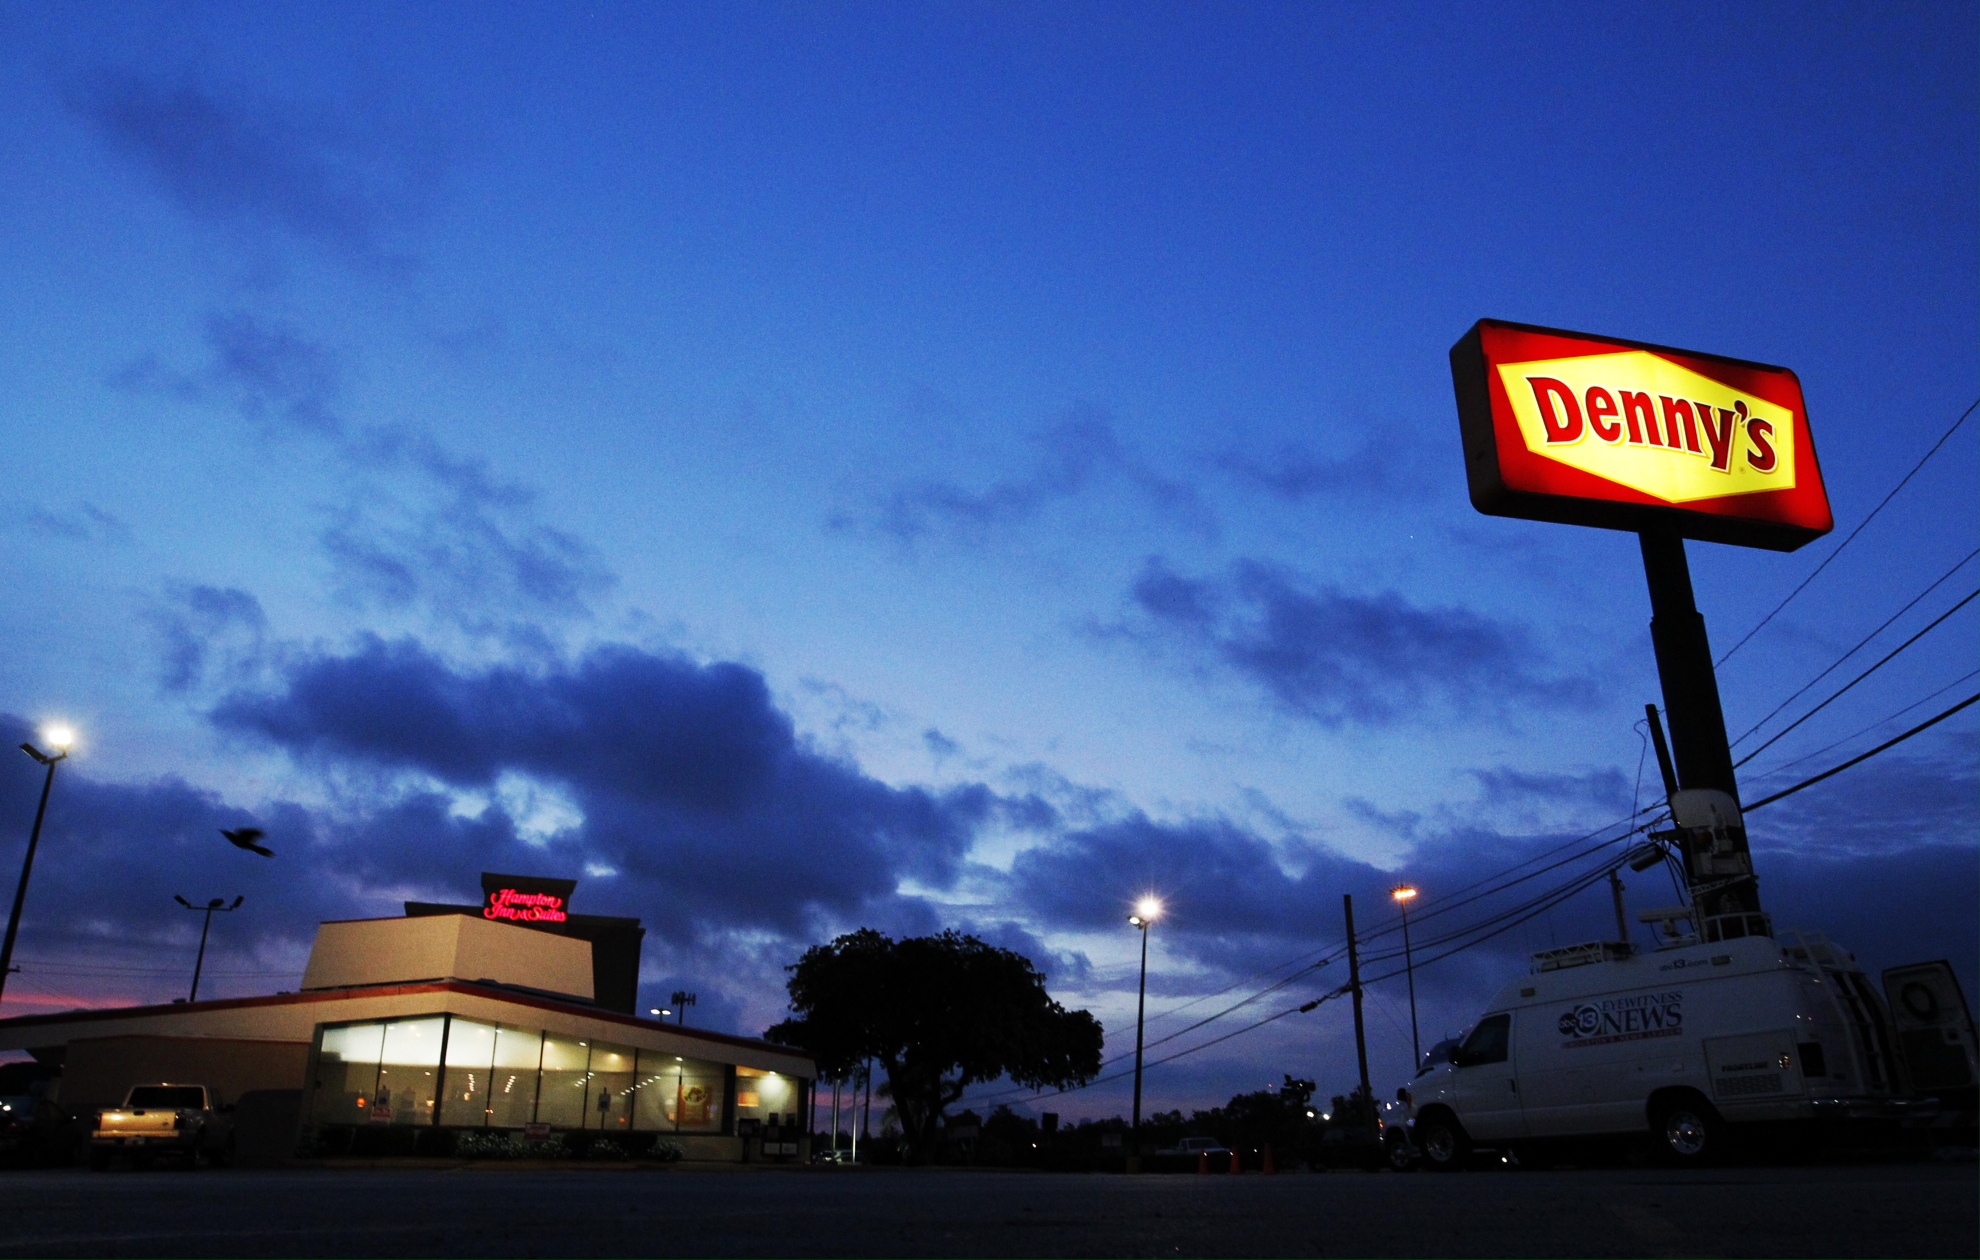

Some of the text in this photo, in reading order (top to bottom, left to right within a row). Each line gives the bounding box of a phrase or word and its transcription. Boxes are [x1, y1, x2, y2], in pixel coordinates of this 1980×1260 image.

[1525, 376, 1777, 473] Denny's
[490, 889, 563, 909] Hampton
[484, 905, 519, 920] Inn
[528, 906, 567, 922] Suites
[1601, 991, 1683, 1011] EYEWITNESS
[1579, 1012, 1597, 1029] 13
[1601, 1003, 1683, 1035] NEWS
